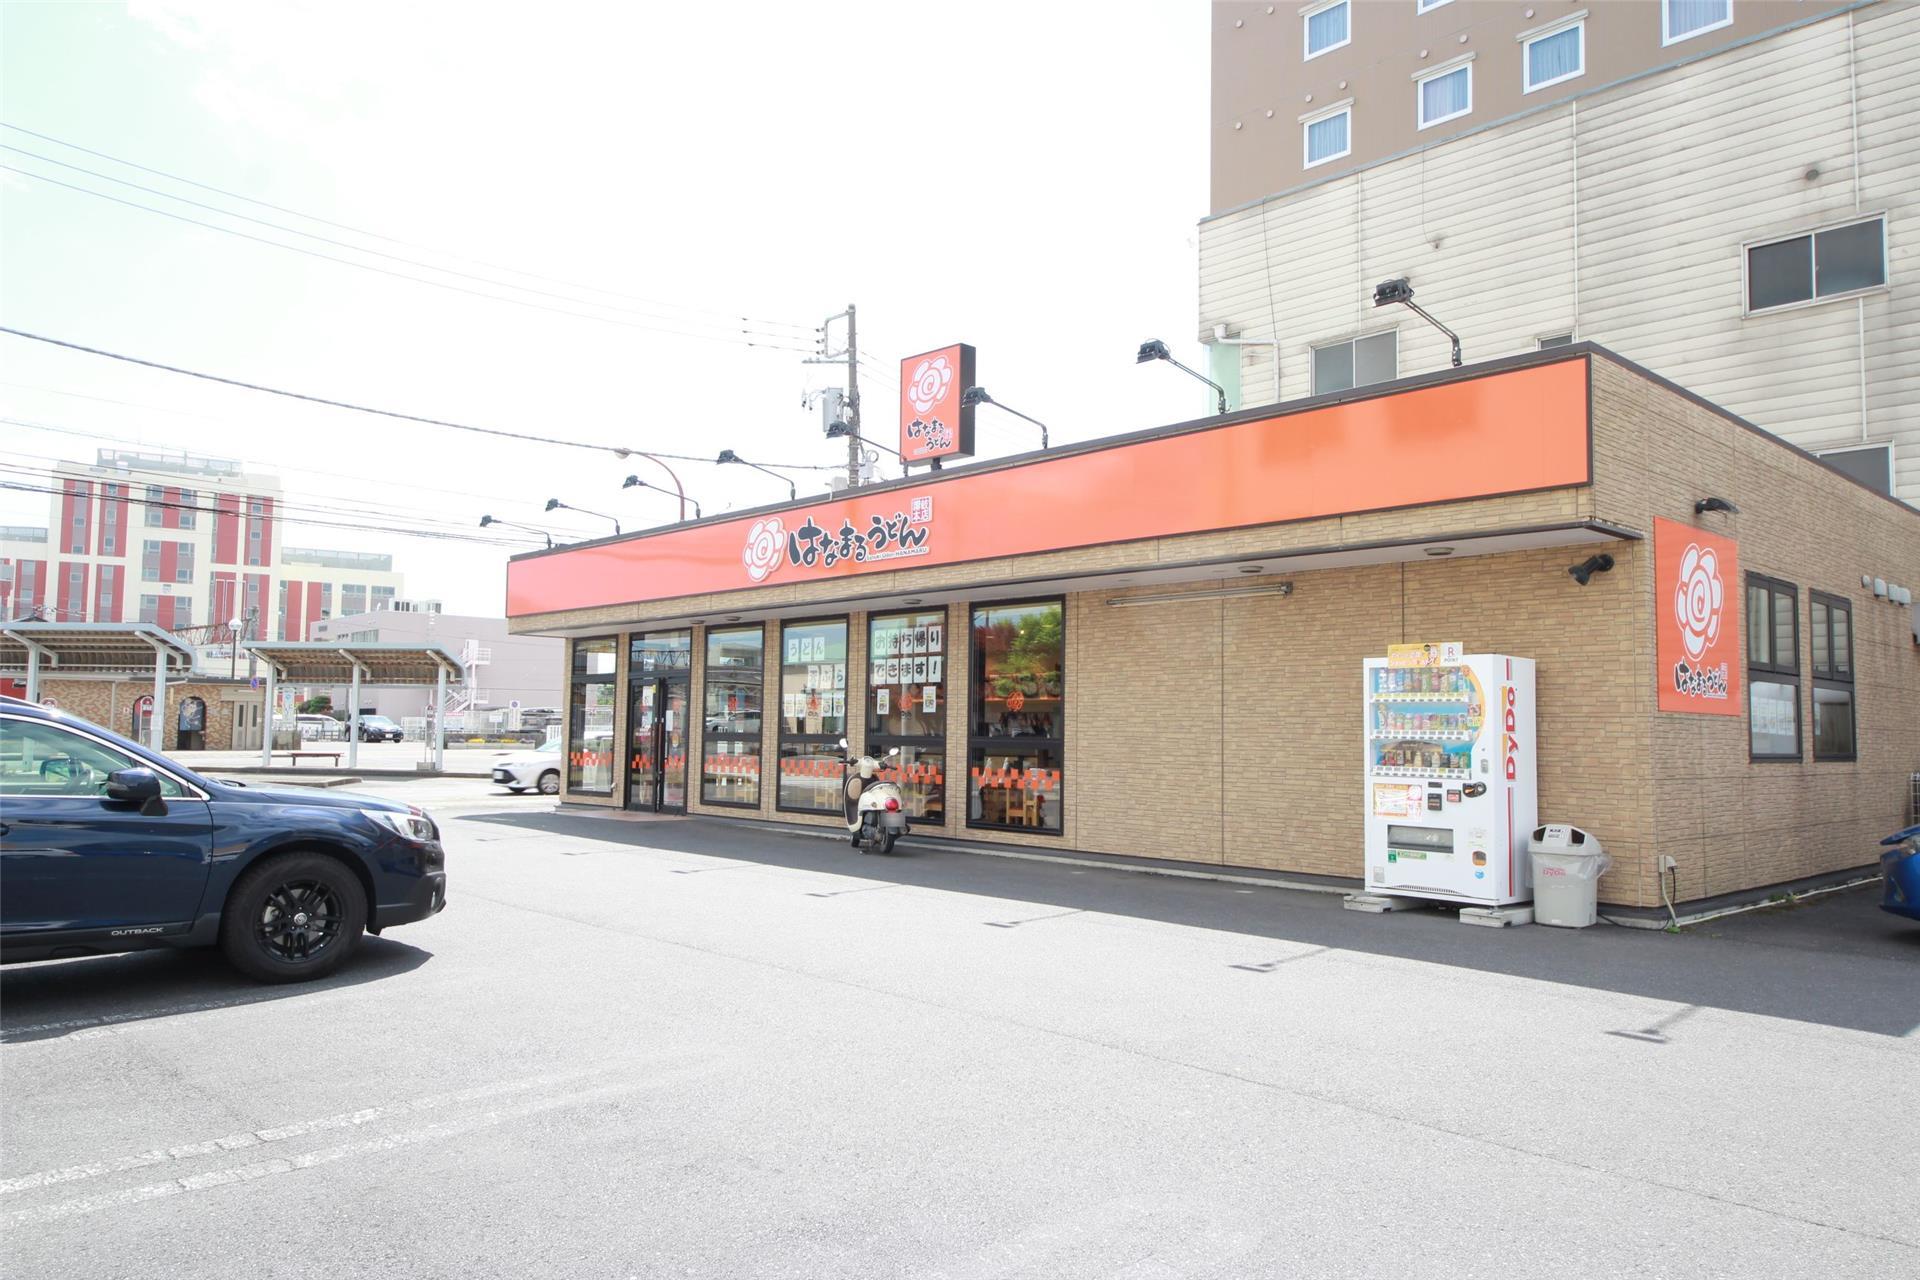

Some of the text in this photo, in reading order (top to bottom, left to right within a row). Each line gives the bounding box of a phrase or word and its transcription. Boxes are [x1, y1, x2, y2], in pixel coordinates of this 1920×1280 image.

[788, 513, 927, 567] はなまるうどん
[875, 630, 940, 649] お持ち帰り
[790, 641, 824, 657] うどん
[875, 661, 938, 678] できます！
[111, 927, 164, 936] OUTBACK
